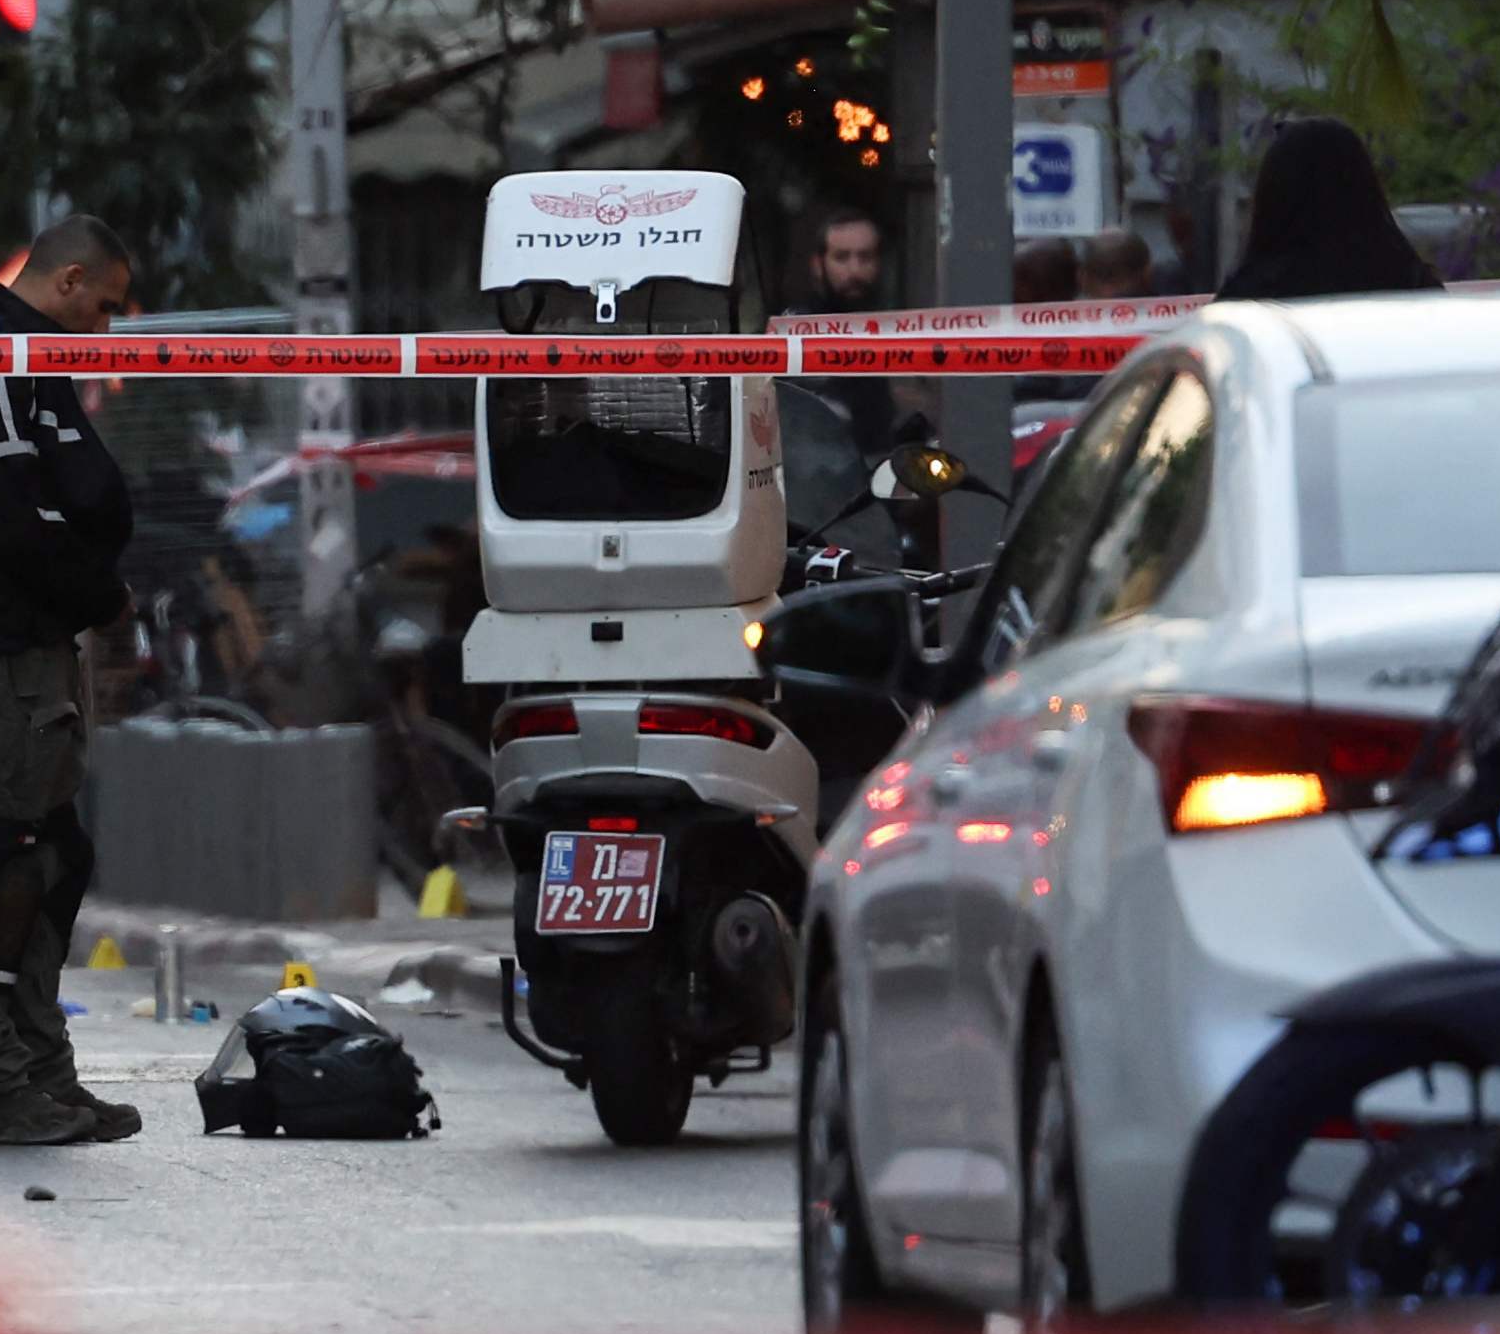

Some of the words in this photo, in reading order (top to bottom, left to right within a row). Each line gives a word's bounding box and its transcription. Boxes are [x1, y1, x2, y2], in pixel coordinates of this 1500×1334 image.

[516, 230, 621, 248] משטרה
[638, 226, 702, 247] חבלן
[39, 346, 102, 364] מעבר
[110, 346, 140, 367] אין
[185, 343, 257, 365] ישראל
[305, 345, 394, 365] משטרת
[428, 346, 491, 365] מעבר
[499, 347, 529, 369] אין
[573, 345, 645, 366] ישראל
[692, 346, 779, 365] משטרת
[814, 347, 877, 365] מעבר
[885, 347, 914, 368] אין
[959, 344, 1032, 365] ישראל
[592, 844, 618, 880] מ
